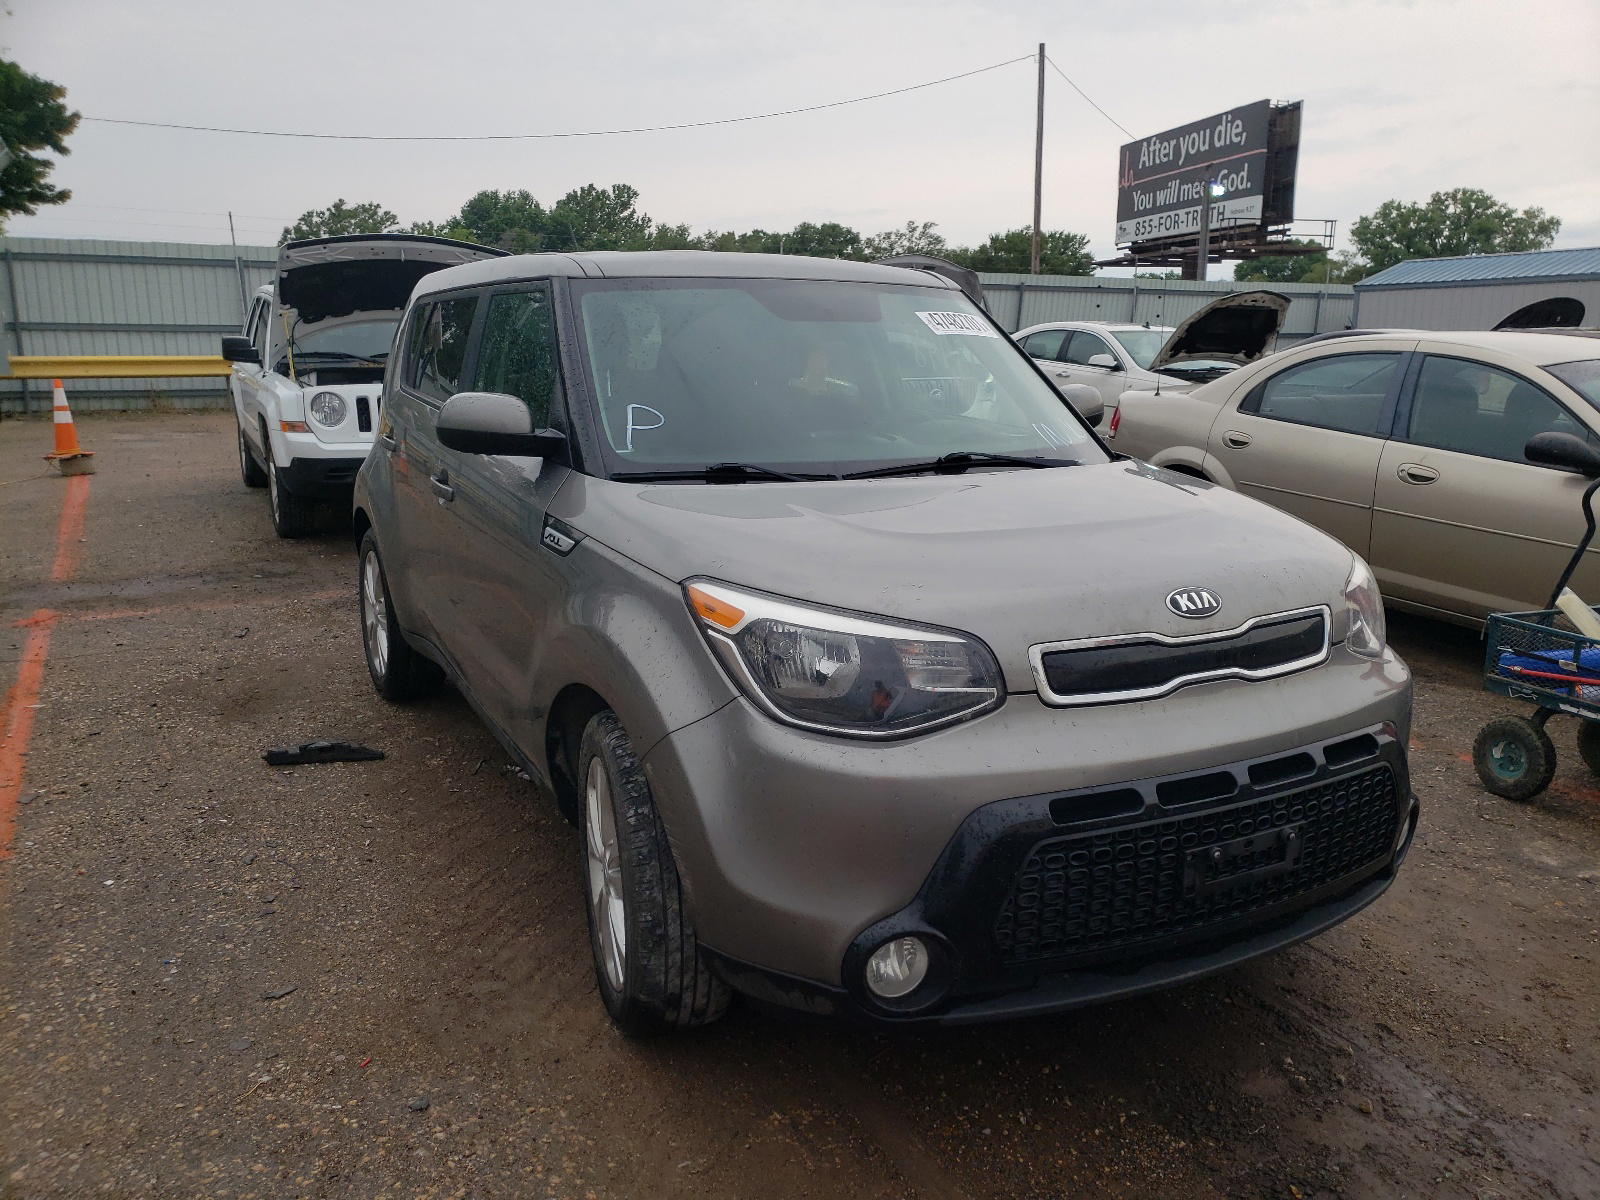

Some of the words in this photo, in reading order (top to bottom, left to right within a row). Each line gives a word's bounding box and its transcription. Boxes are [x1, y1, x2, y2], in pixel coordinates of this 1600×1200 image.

[1139, 137, 1176, 169] After
[1179, 128, 1209, 165] you
[1214, 114, 1246, 145] die,
[1133, 189, 1152, 212] You
[1156, 179, 1177, 206] will
[1180, 180, 1207, 200] mee
[1216, 163, 1251, 194] God.
[1135, 204, 1226, 236] 855-FOR-TRTH
[626, 403, 665, 452] P
[1173, 591, 1218, 612] KIA
